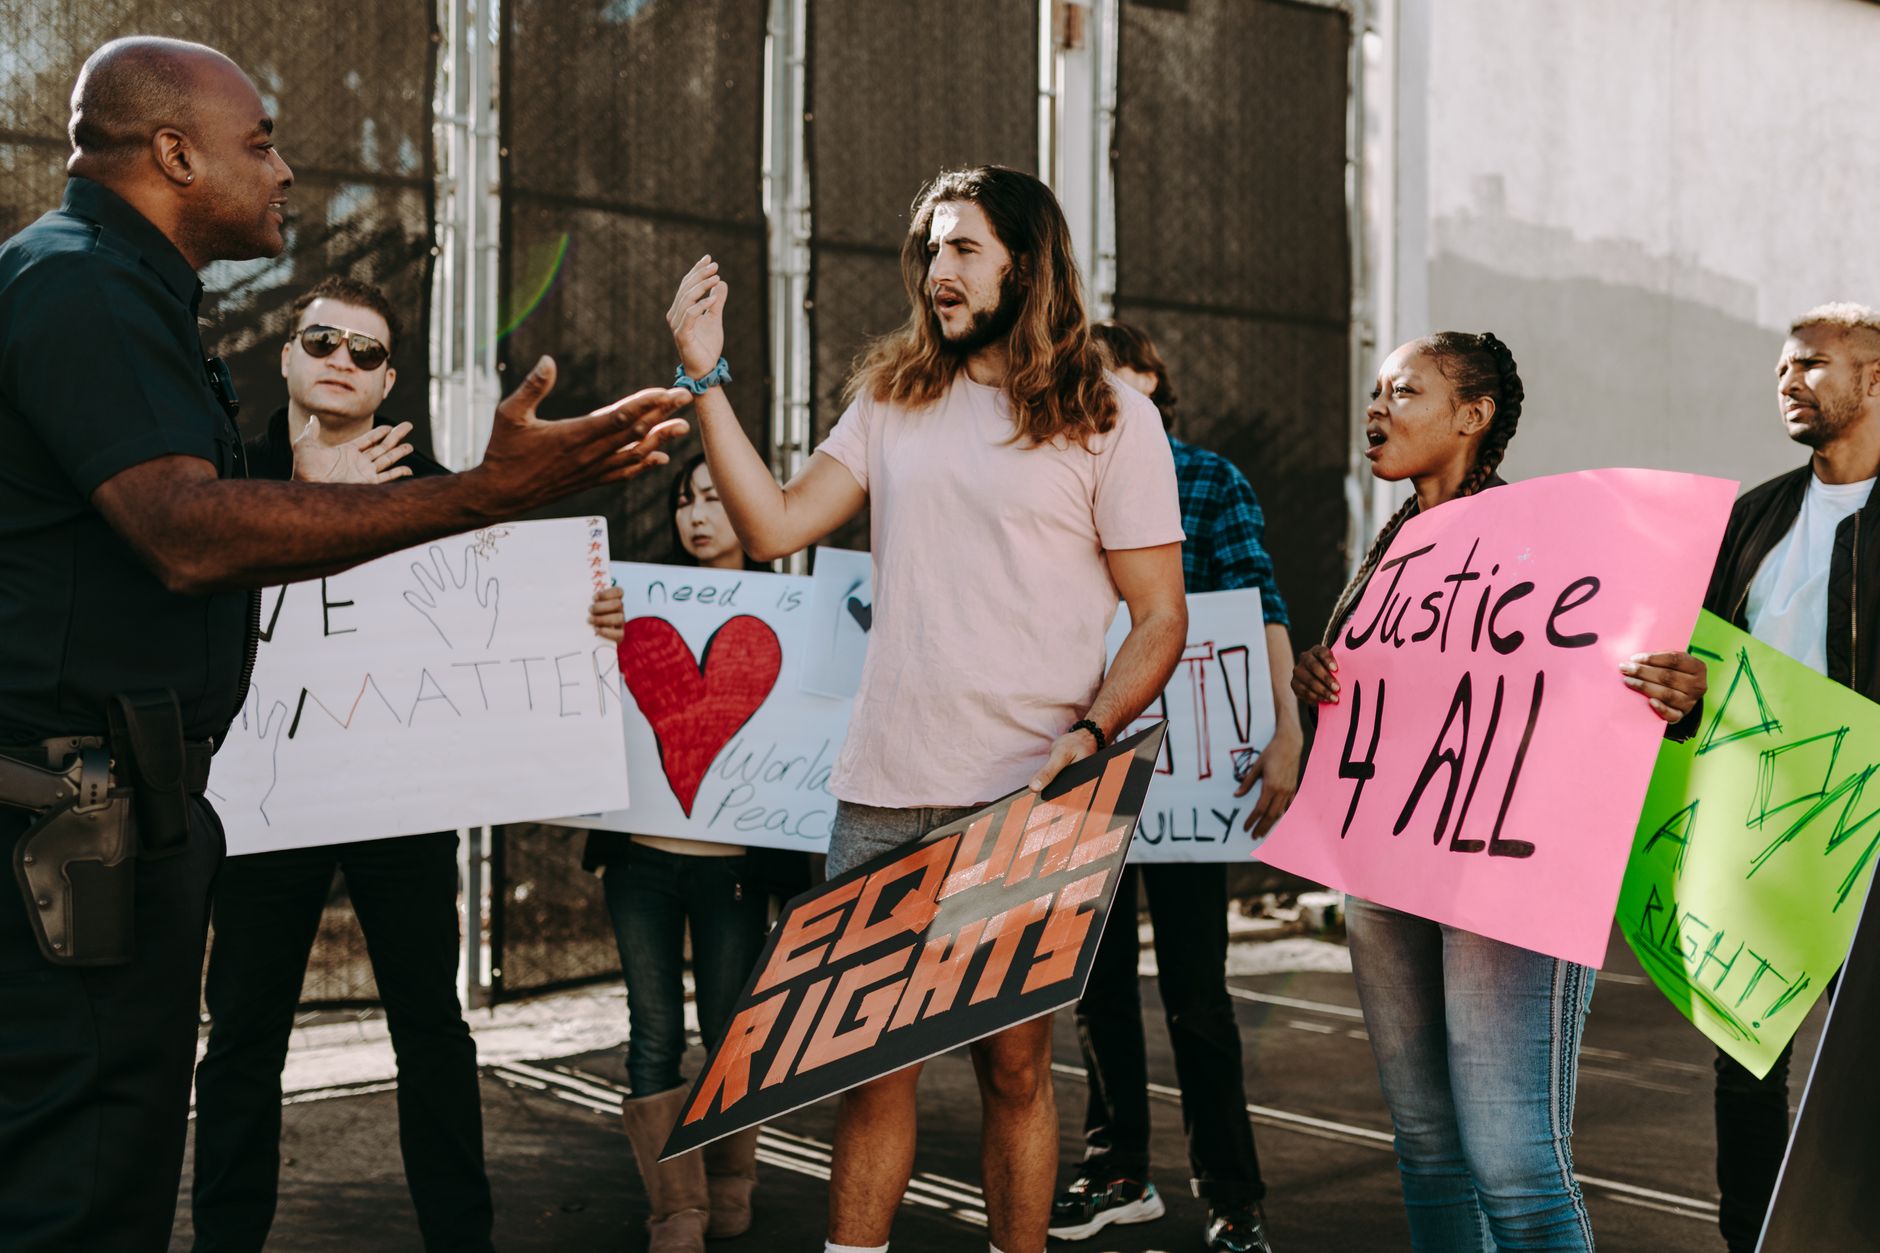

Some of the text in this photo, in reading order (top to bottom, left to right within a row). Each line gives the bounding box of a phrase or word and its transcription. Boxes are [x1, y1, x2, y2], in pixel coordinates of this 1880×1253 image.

[648, 579, 803, 612] need is
[1345, 537, 1600, 655] Justice
[289, 645, 621, 740] MATTER
[707, 782, 836, 840] Peac
[1338, 669, 1544, 859] 4 ALL
[752, 748, 1137, 996] EQUAL
[1133, 807, 1240, 845] ULLY
[1642, 798, 1700, 880] A
[683, 868, 1111, 1127] RIGHTS
[1637, 883, 1812, 1029] RIGHT!
